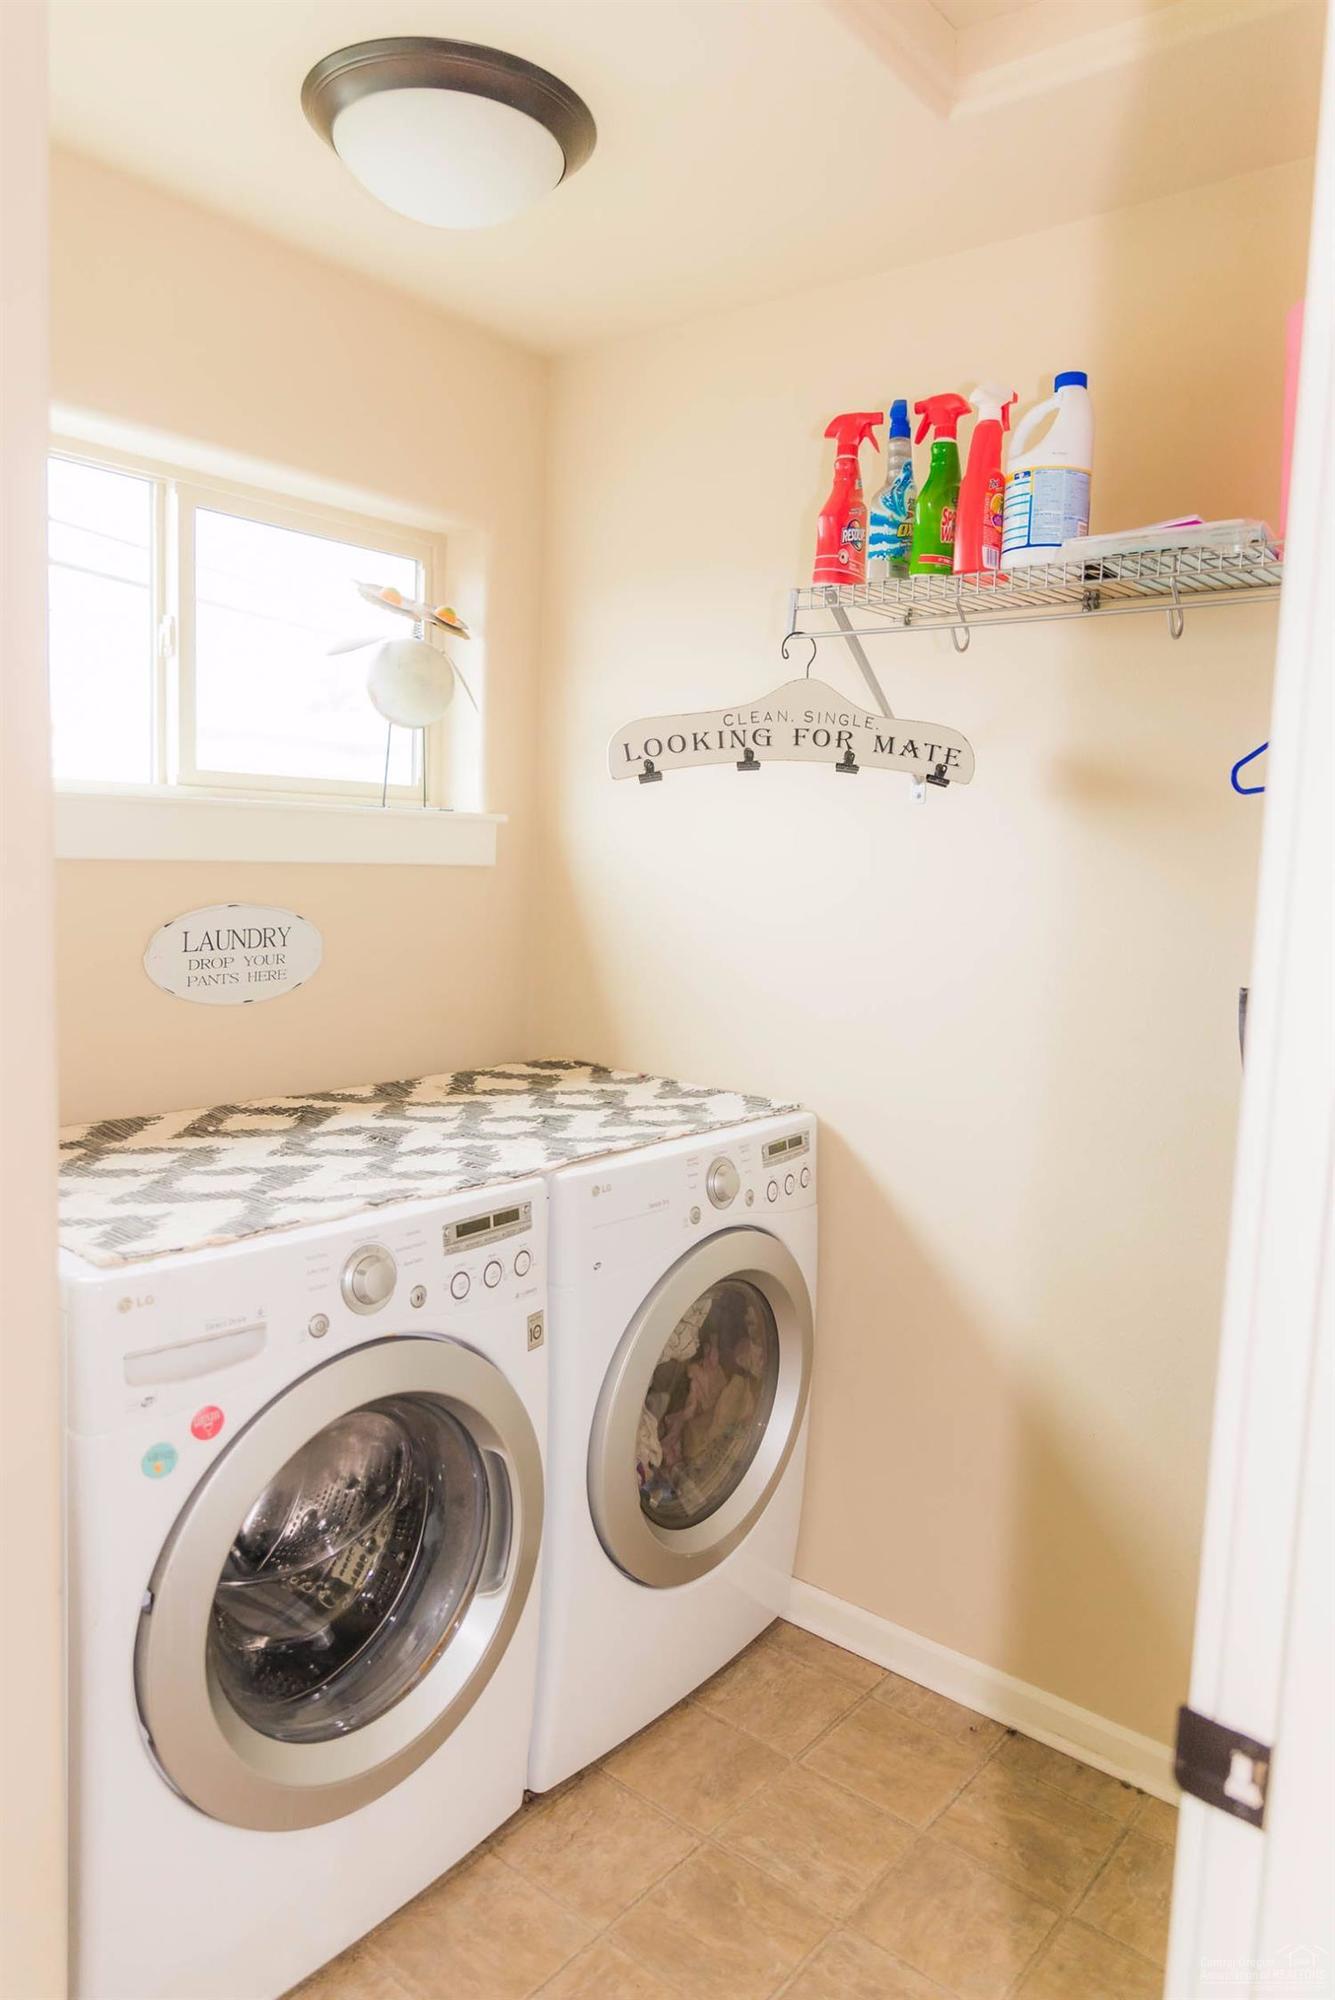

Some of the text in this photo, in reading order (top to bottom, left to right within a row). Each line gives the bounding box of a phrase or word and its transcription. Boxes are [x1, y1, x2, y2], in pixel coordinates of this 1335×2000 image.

[722, 710, 880, 730] CLEAN. SINGLE.
[623, 727, 962, 767] LOOKING FOR MATE
[182, 926, 292, 953] LAUNDRY
[188, 953, 286, 971] DROP YOUR
[186, 968, 288, 987] PANTS HERE
[136, 1294, 155, 1308] LG
